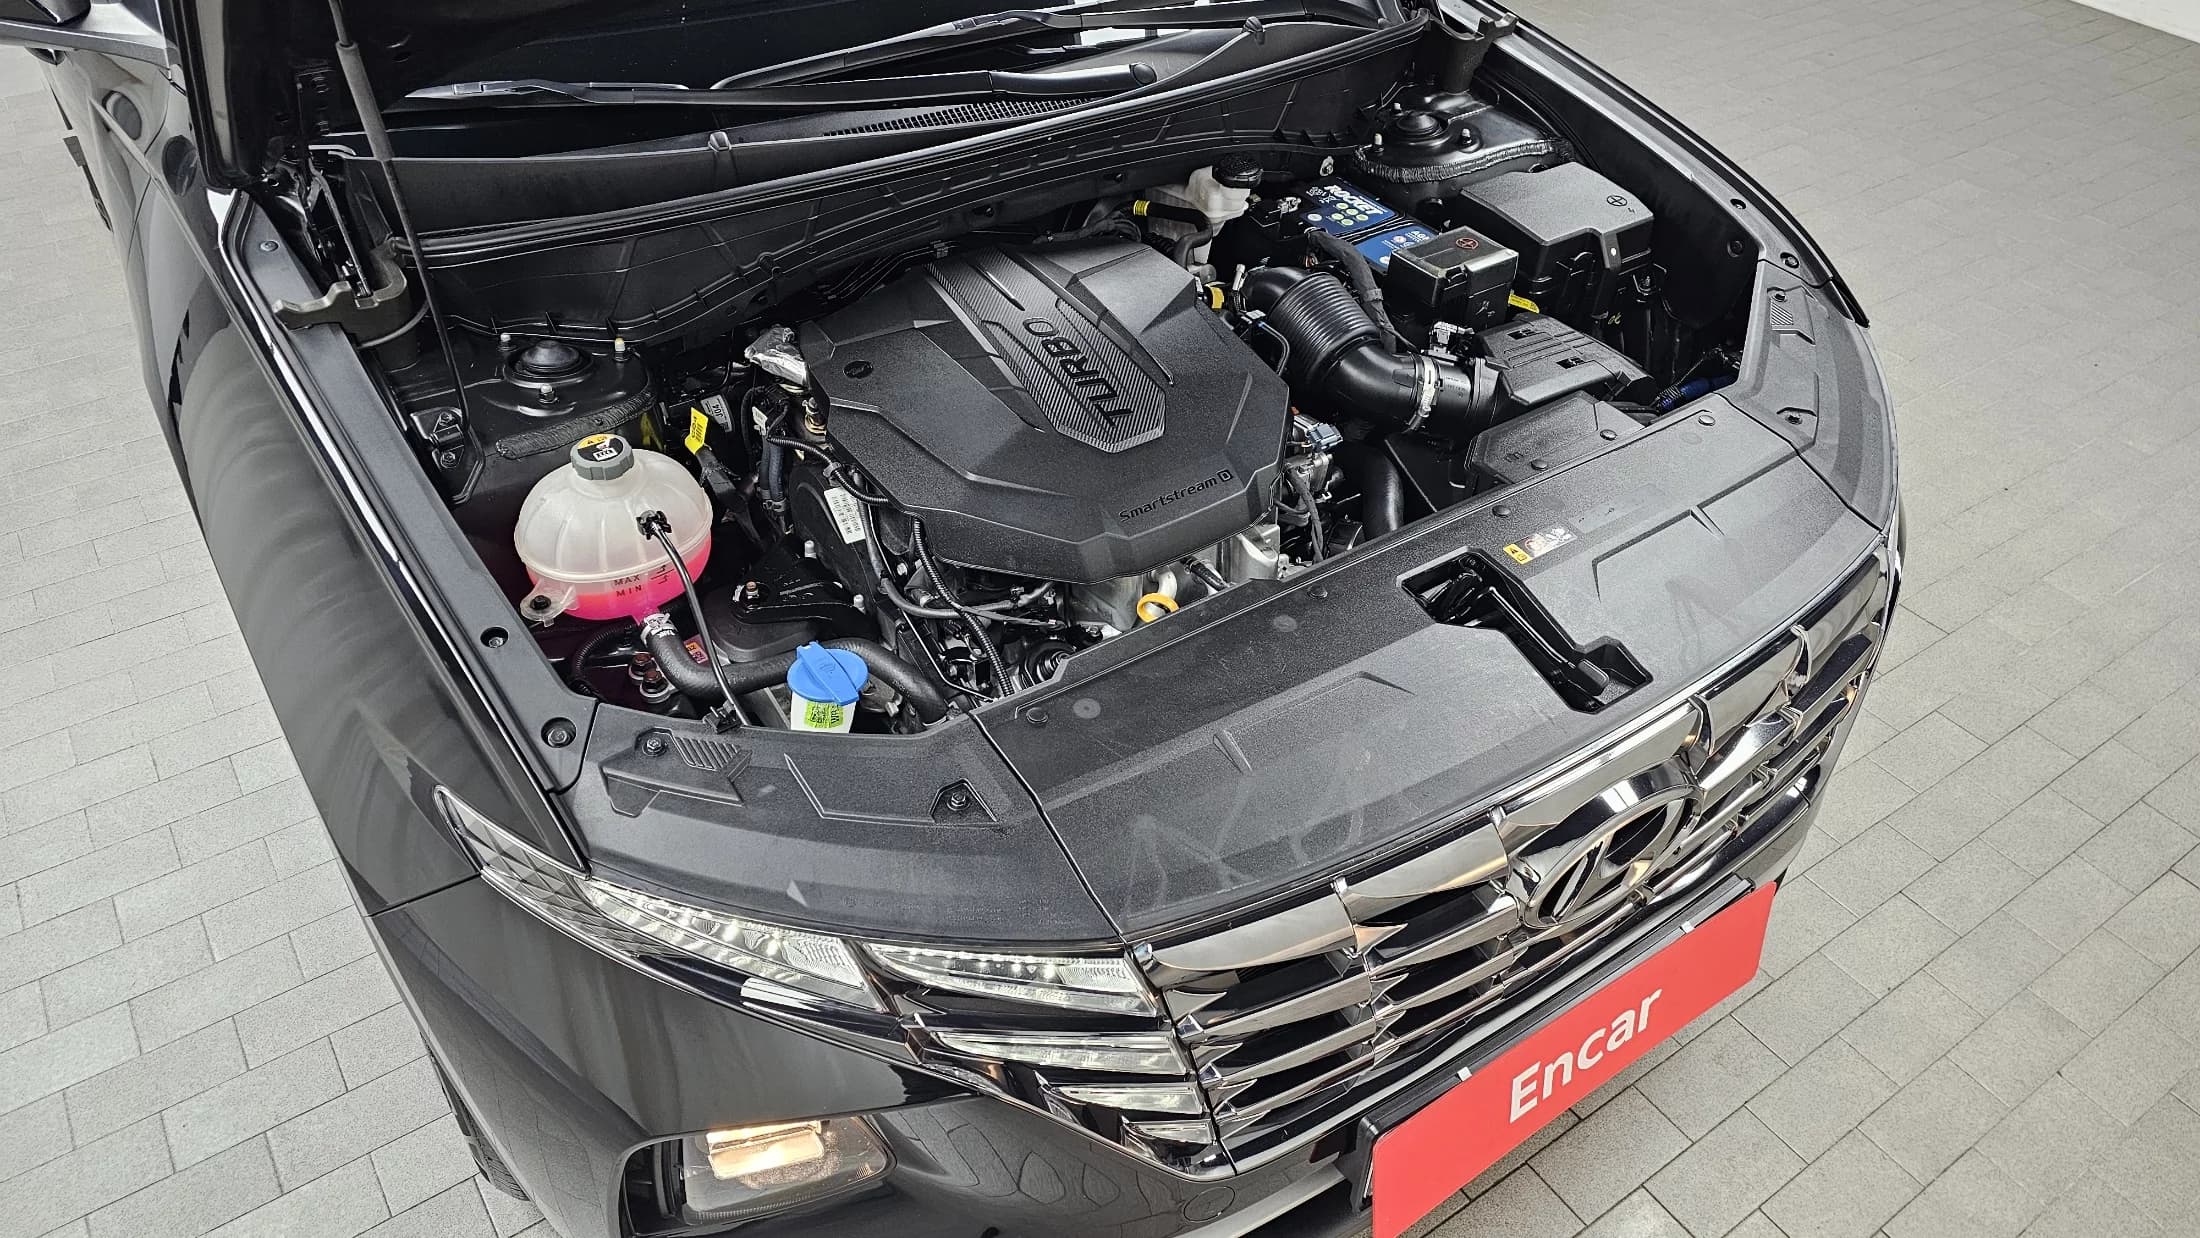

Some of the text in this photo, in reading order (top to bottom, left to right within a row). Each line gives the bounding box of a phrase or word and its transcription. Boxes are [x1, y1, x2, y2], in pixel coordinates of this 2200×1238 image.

[1323, 184, 1385, 215] ROCKET
[1022, 319, 1135, 428] TURBO
[1118, 469, 1233, 523] Smartstream D
[613, 574, 641, 586] MAX
[615, 584, 643, 598] MIN
[1509, 988, 1663, 1124] Encar
